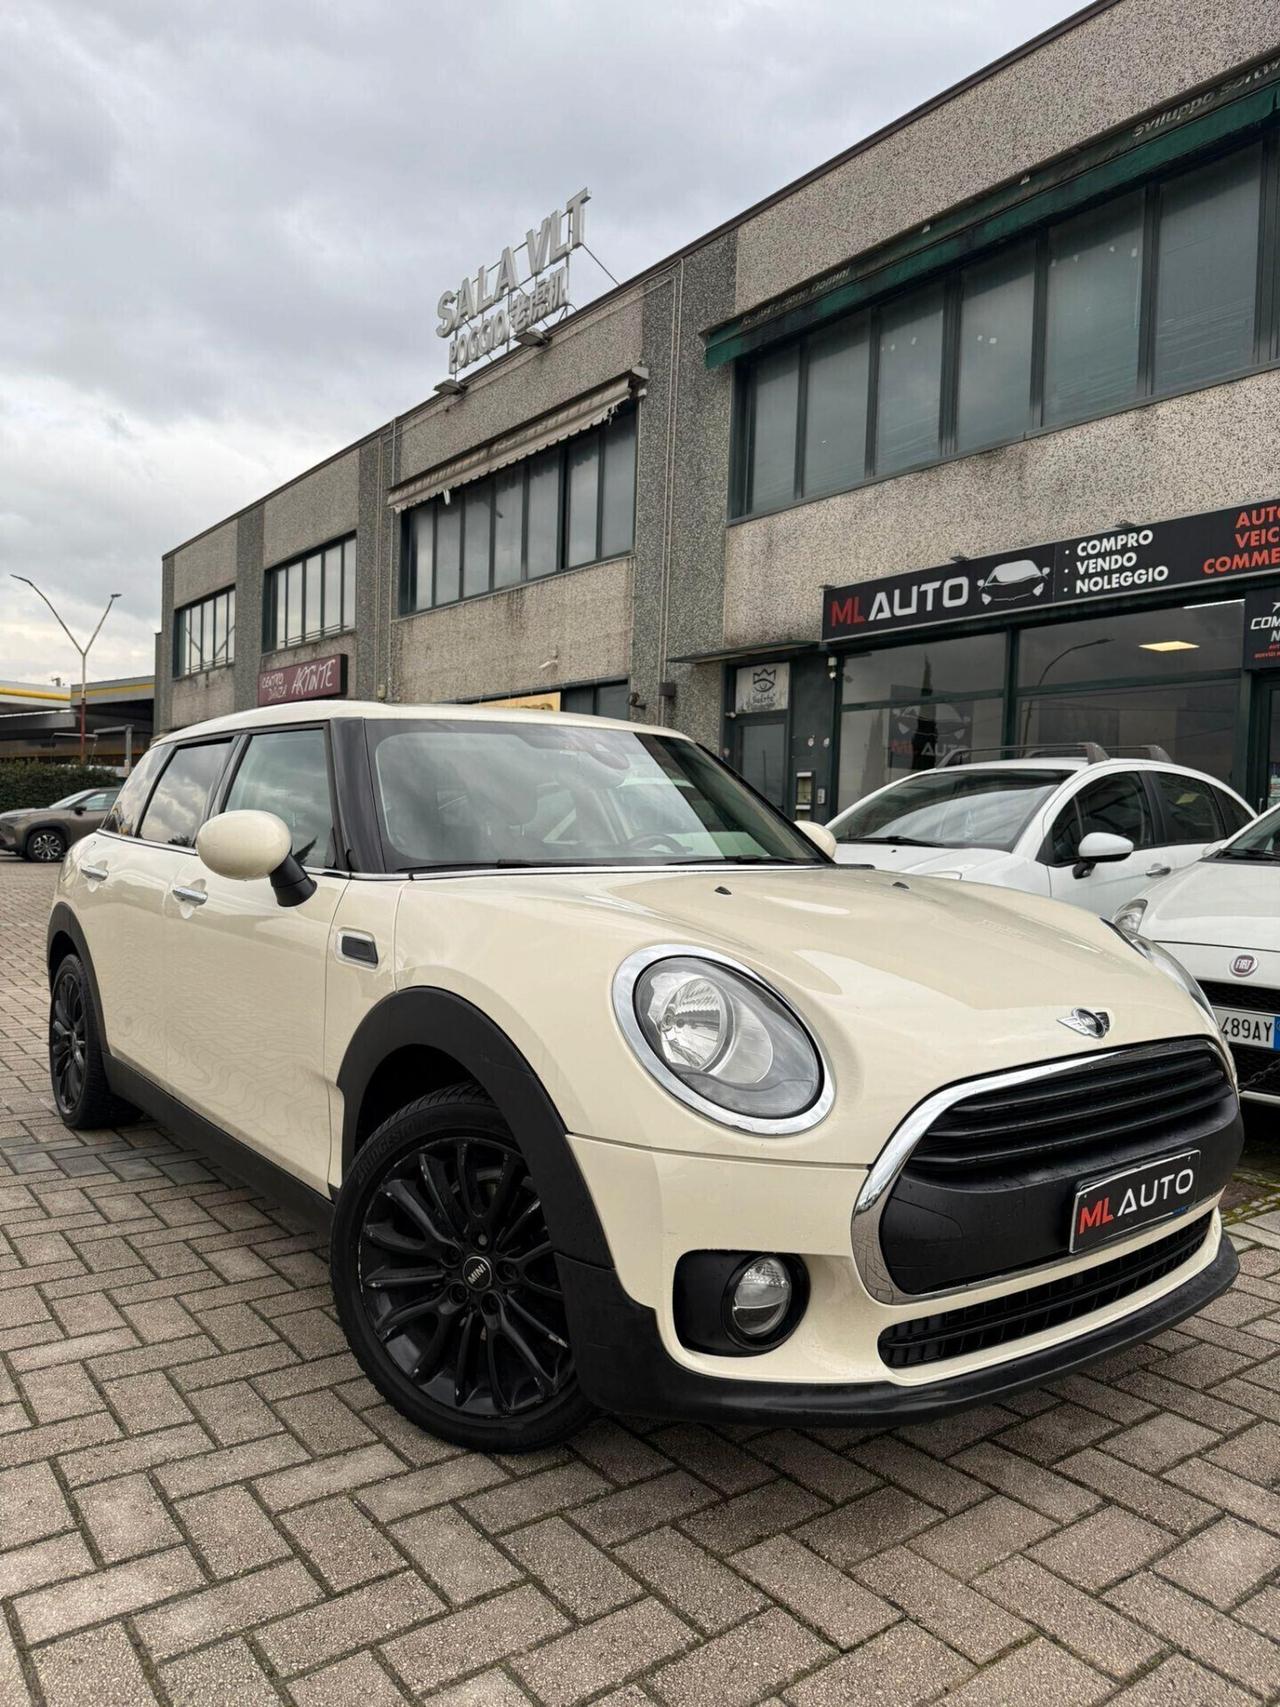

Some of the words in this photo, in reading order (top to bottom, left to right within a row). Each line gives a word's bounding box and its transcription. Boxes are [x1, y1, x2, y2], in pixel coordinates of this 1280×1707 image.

[436, 246, 520, 338] SALA
[525, 187, 592, 276] VLT
[1076, 529, 1154, 557] COMPRO
[1234, 526, 1280, 549] VEIC
[1076, 551, 1138, 575] VENDO
[1203, 546, 1280, 574] COMME
[1075, 565, 1169, 594] NOLEGGIO
[831, 596, 865, 628] ML
[868, 576, 969, 621] AUTO
[1235, 958, 1253, 970] FIAT
[1220, 1016, 1273, 1042] 489AY
[1079, 1196, 1114, 1235] ML
[1117, 1168, 1194, 1217] AUTO
[467, 1263, 487, 1284] MINI
